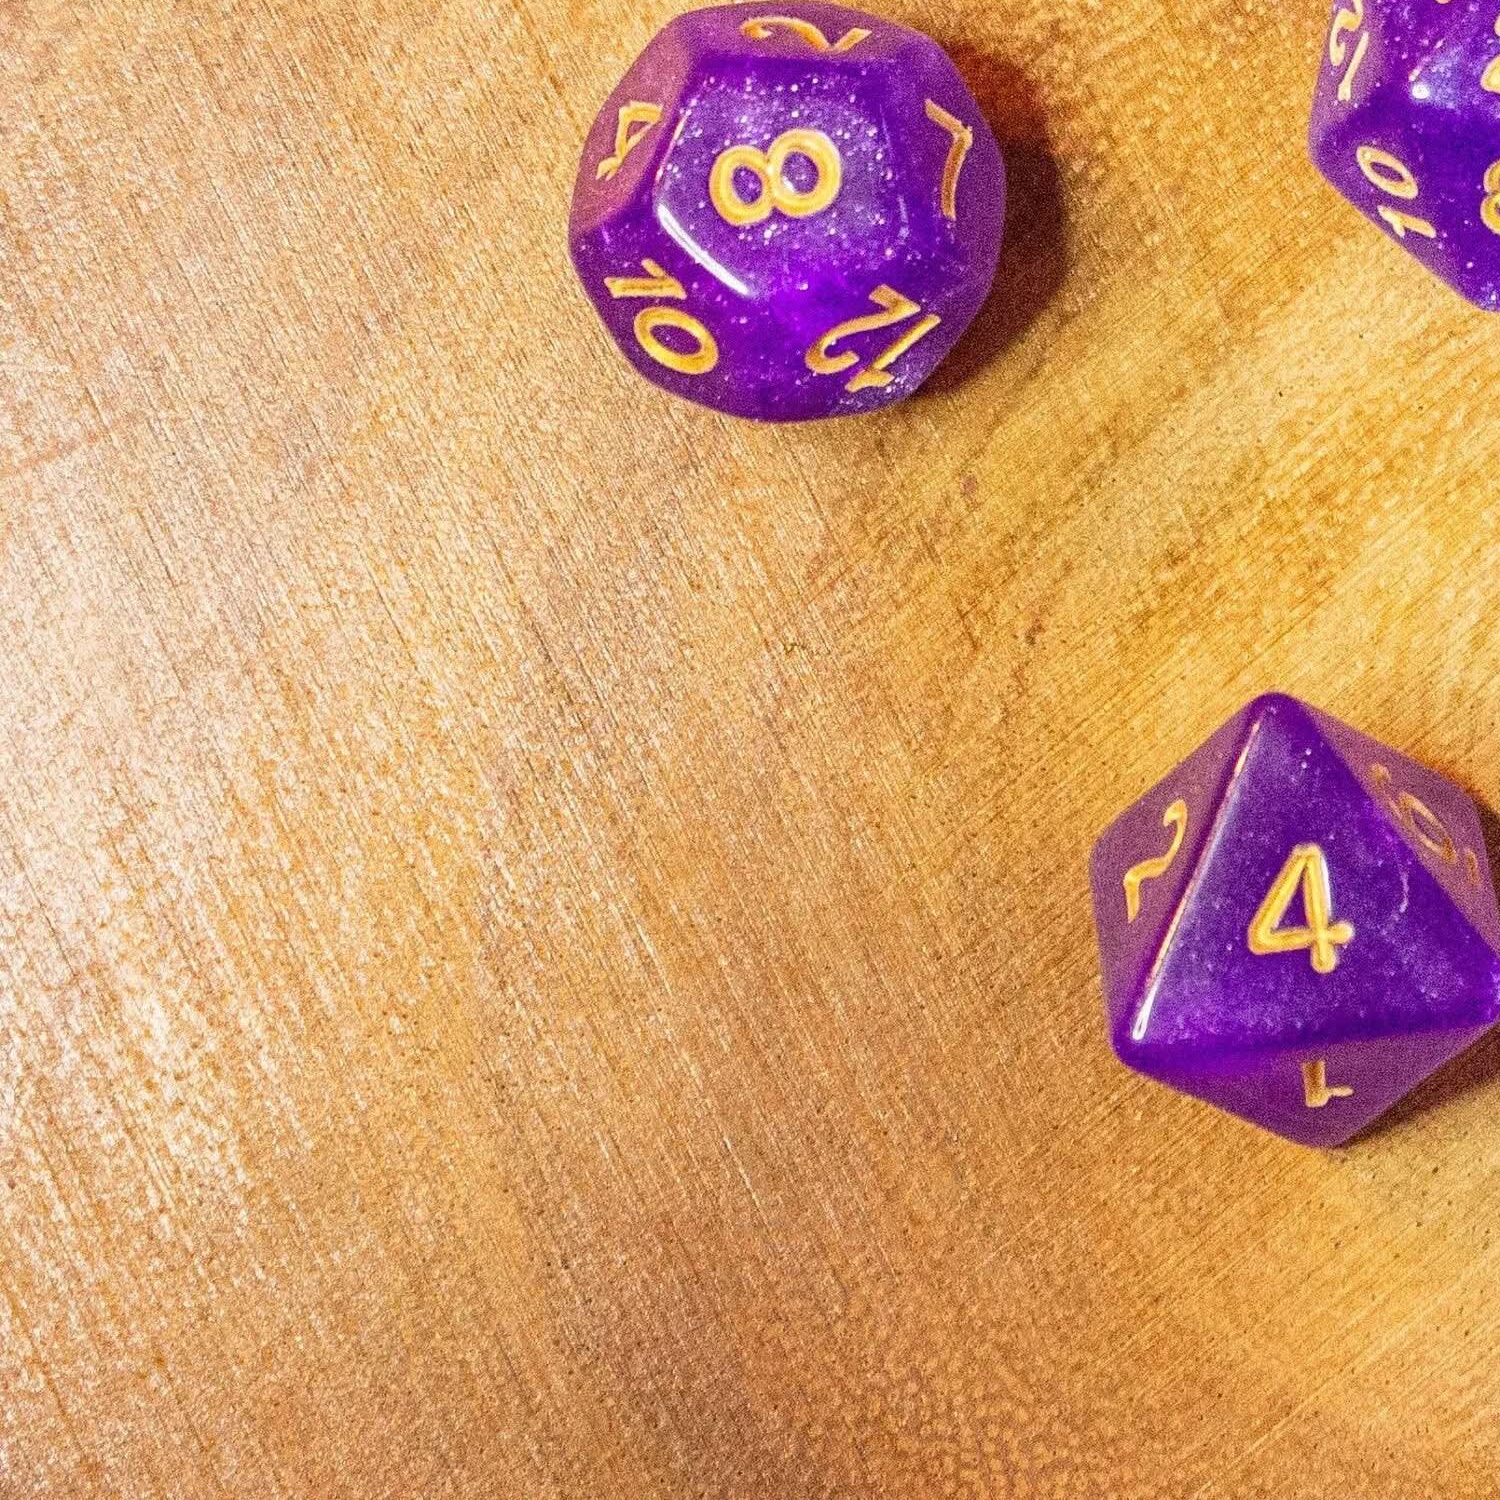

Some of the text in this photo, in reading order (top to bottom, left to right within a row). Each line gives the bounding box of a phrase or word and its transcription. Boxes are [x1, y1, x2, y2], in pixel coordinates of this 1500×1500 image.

[709, 127, 842, 226] 8
[1357, 146, 1437, 239] 10
[604, 258, 719, 376] 10
[805, 284, 942, 392] 12
[1248, 843, 1354, 974] 4
